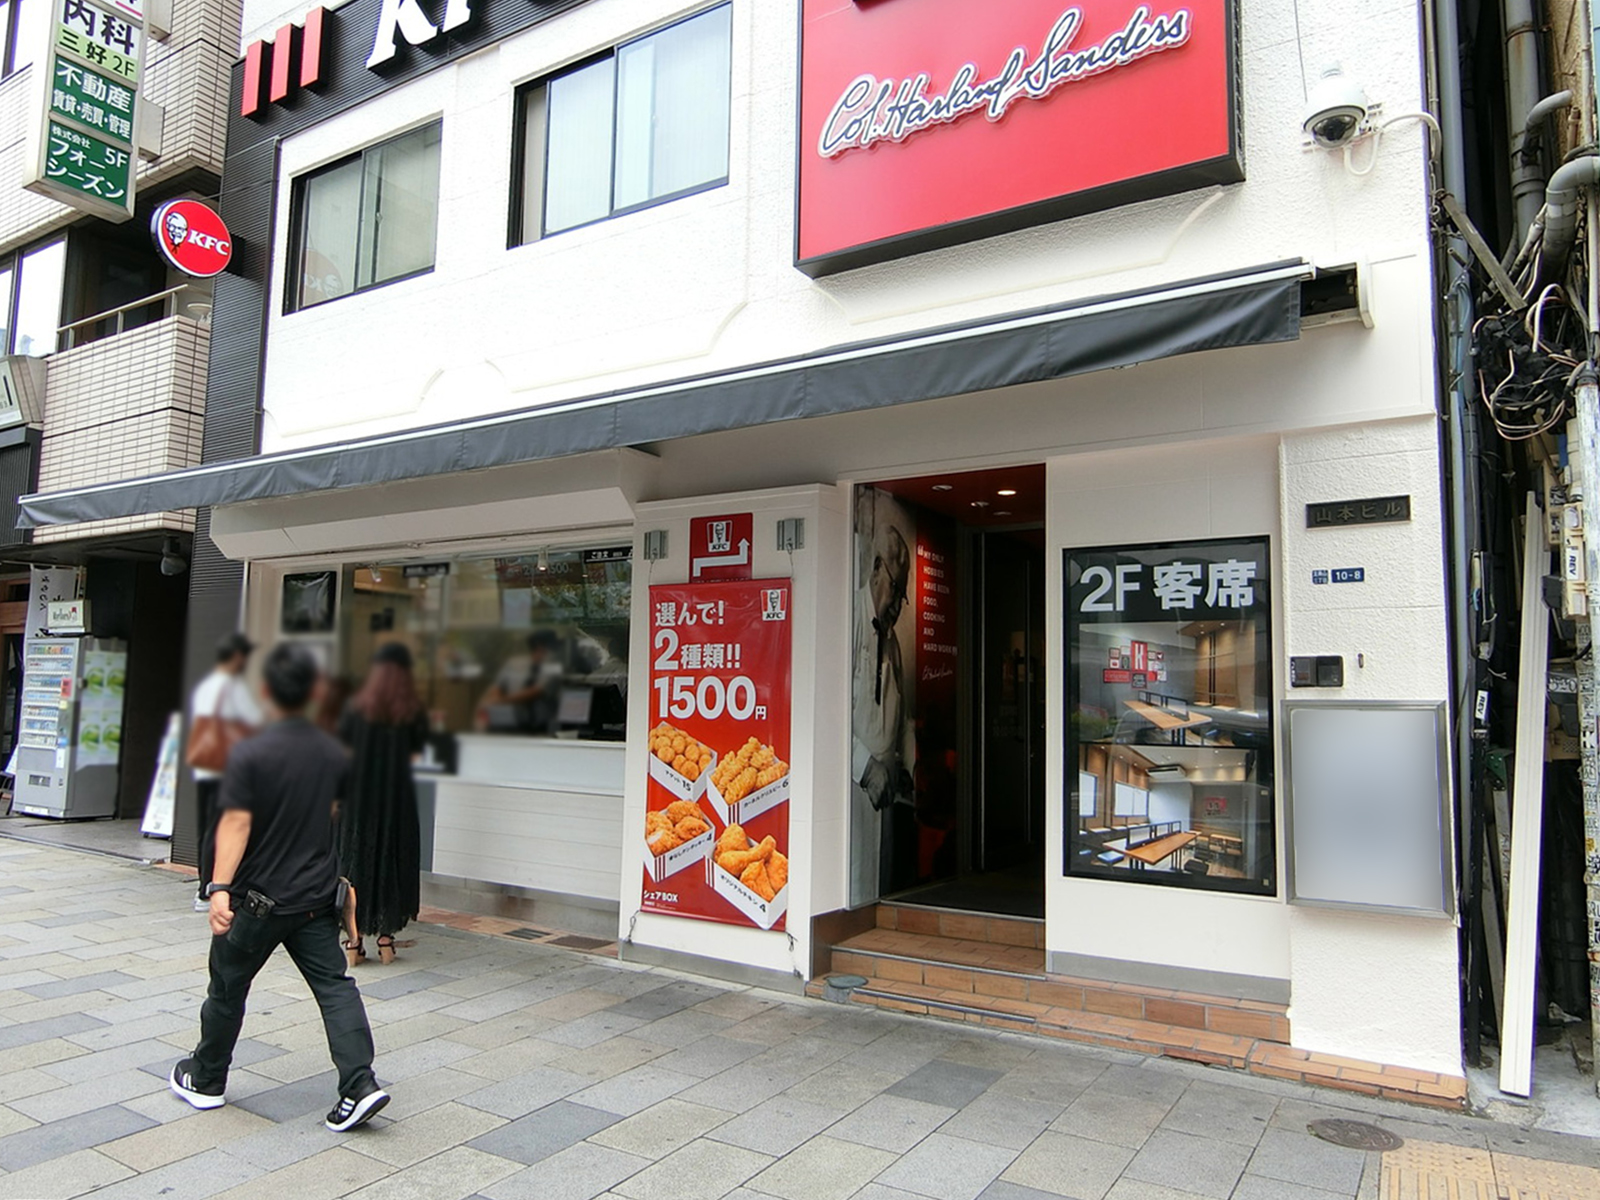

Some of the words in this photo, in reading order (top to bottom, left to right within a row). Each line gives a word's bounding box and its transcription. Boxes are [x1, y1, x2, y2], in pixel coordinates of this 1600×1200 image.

[63, 0, 134, 55] 内科
[59, 29, 107, 64] 三好
[113, 55, 135, 76] 2F
[1020, 5, 1193, 99] Sanders
[56, 60, 131, 113] 不動産
[50, 137, 106, 169] フォー
[51, 126, 91, 149] 株式会社
[104, 147, 128, 167] 5F
[47, 157, 124, 198] シーズン
[187, 228, 230, 256] KFC
[1316, 502, 1400, 522] 山本ビル
[1079, 564, 1142, 612] 2F
[1153, 559, 1256, 610] 客席
[1335, 571, 1362, 580] 10-8
[655, 600, 724, 627] 選んで!
